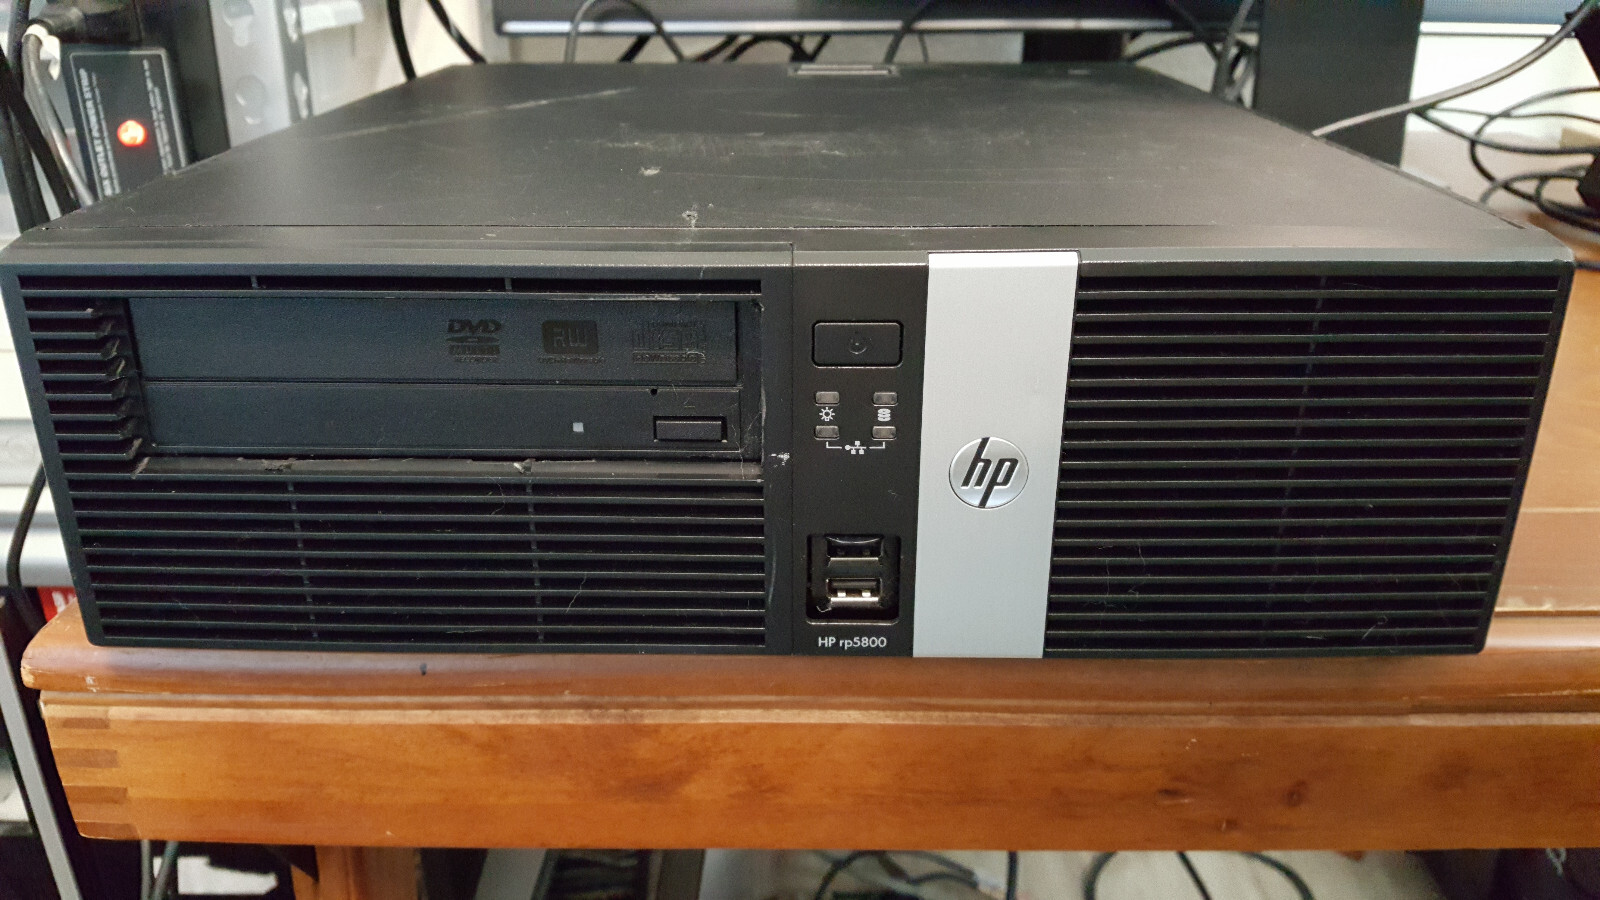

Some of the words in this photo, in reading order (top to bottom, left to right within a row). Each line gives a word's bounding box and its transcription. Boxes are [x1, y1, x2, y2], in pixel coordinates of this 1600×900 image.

[79, 68, 92, 99] STRIP
[86, 100, 99, 138] POWER
[446, 318, 502, 335] DVD
[551, 327, 588, 347] RW
[960, 436, 1019, 509] hp
[817, 636, 837, 647] HP
[839, 636, 888, 651] rp5800
